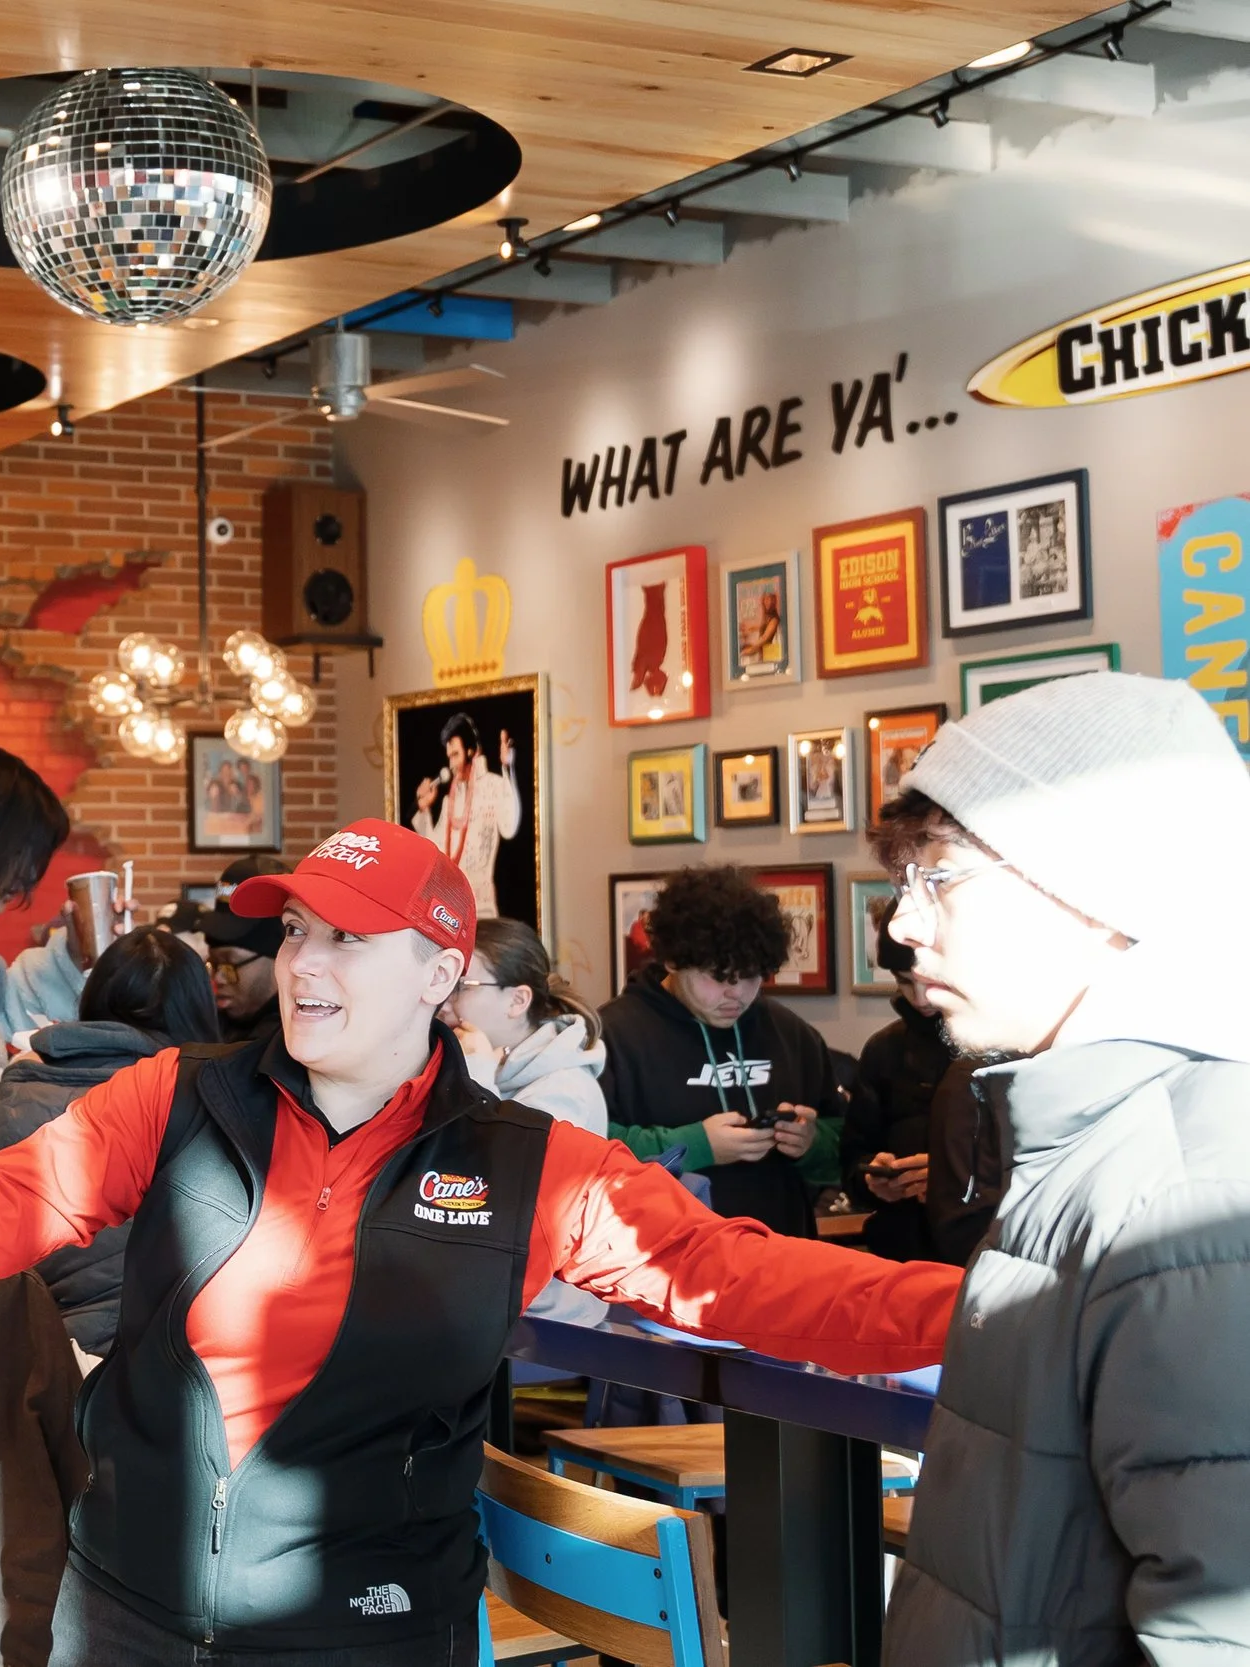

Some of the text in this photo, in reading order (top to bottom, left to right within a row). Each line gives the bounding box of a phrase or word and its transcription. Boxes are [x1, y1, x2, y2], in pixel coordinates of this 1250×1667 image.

[561, 429, 687, 518] WHAT
[700, 397, 804, 485] ARE
[839, 548, 899, 578] EDISON
[852, 626, 886, 640] ALUMNI
[433, 905, 460, 929] Cane's
[686, 1052, 773, 1087] JETS
[419, 1171, 488, 1201] Cane's
[414, 1203, 490, 1225] ONE LOVE
[349, 1595, 390, 1608] NORTH
[366, 1585, 389, 1597] THE
[362, 1603, 391, 1615] FACE
